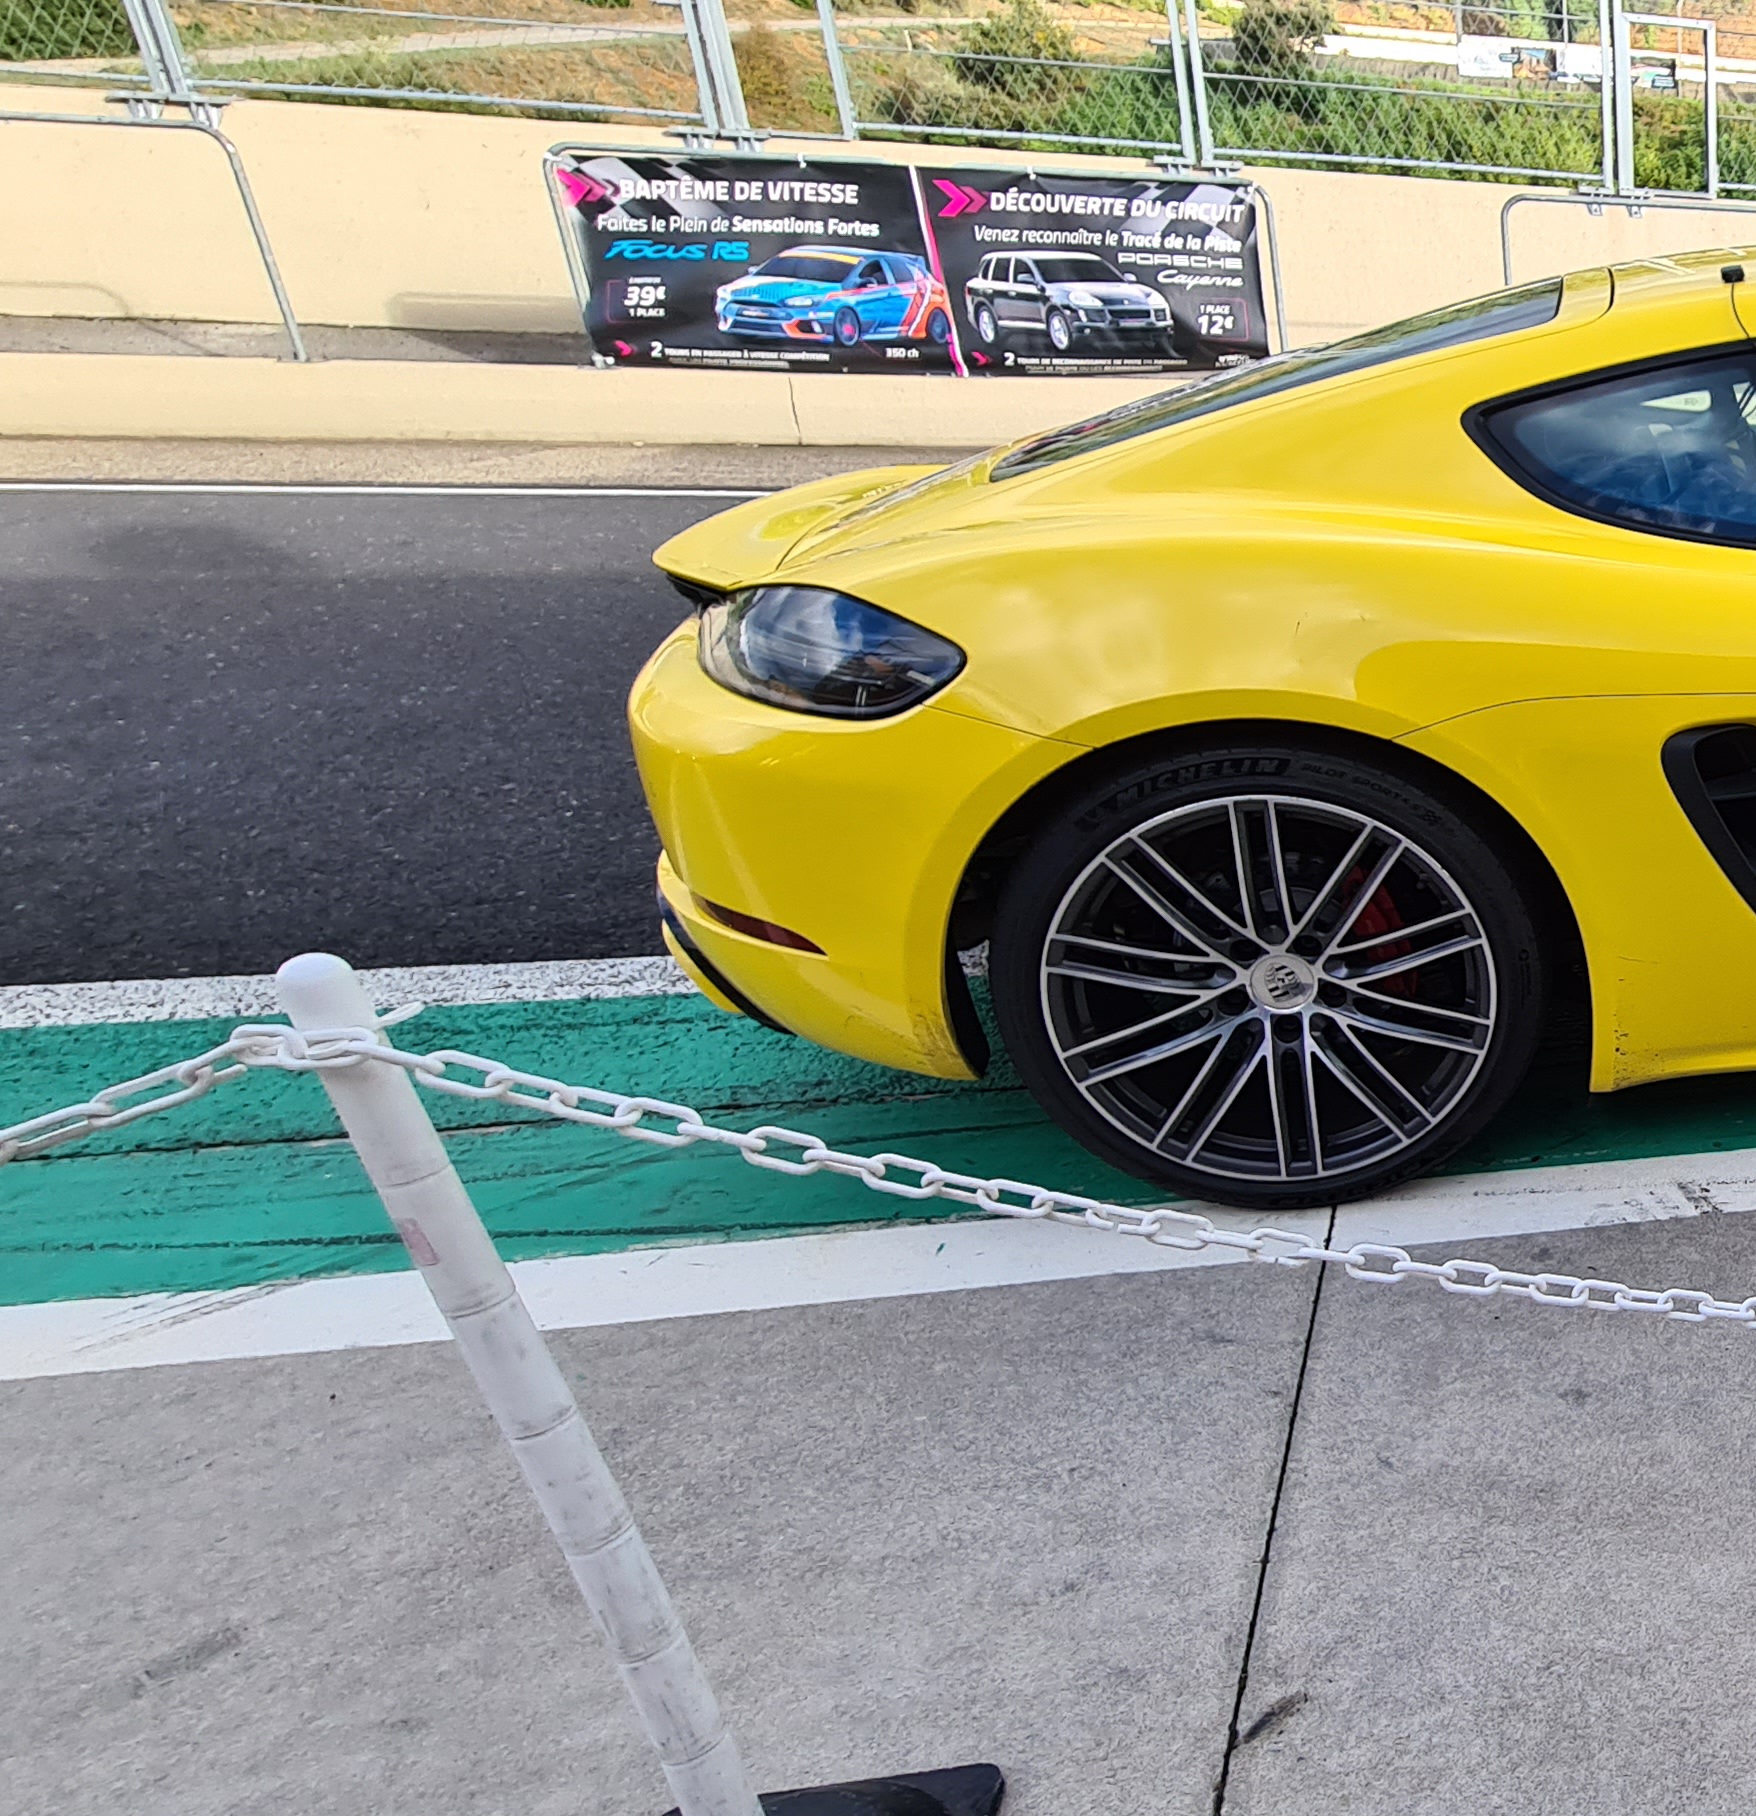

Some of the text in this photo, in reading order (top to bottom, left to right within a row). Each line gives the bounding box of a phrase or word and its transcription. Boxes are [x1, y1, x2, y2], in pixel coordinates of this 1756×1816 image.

[619, 175, 860, 205] BAPTÊME DE VITESSE
[989, 187, 1245, 223] DÉCOUVERTE DU CIRCUIT
[597, 216, 880, 237] Faites le Plein de Sensations Fortes
[974, 225, 1242, 252] Venez reconnaître le Tracé de la Piste
[711, 240, 750, 261] RS
[1117, 252, 1244, 270] PORSCHE
[1156, 269, 1244, 290] Cayenne
[1206, 305, 1231, 314] PLACE
[650, 341, 663, 357] 2
[1003, 352, 1015, 366] 2
[1116, 757, 1281, 802] MICHELIN
[1301, 762, 1346, 779] PILOT
